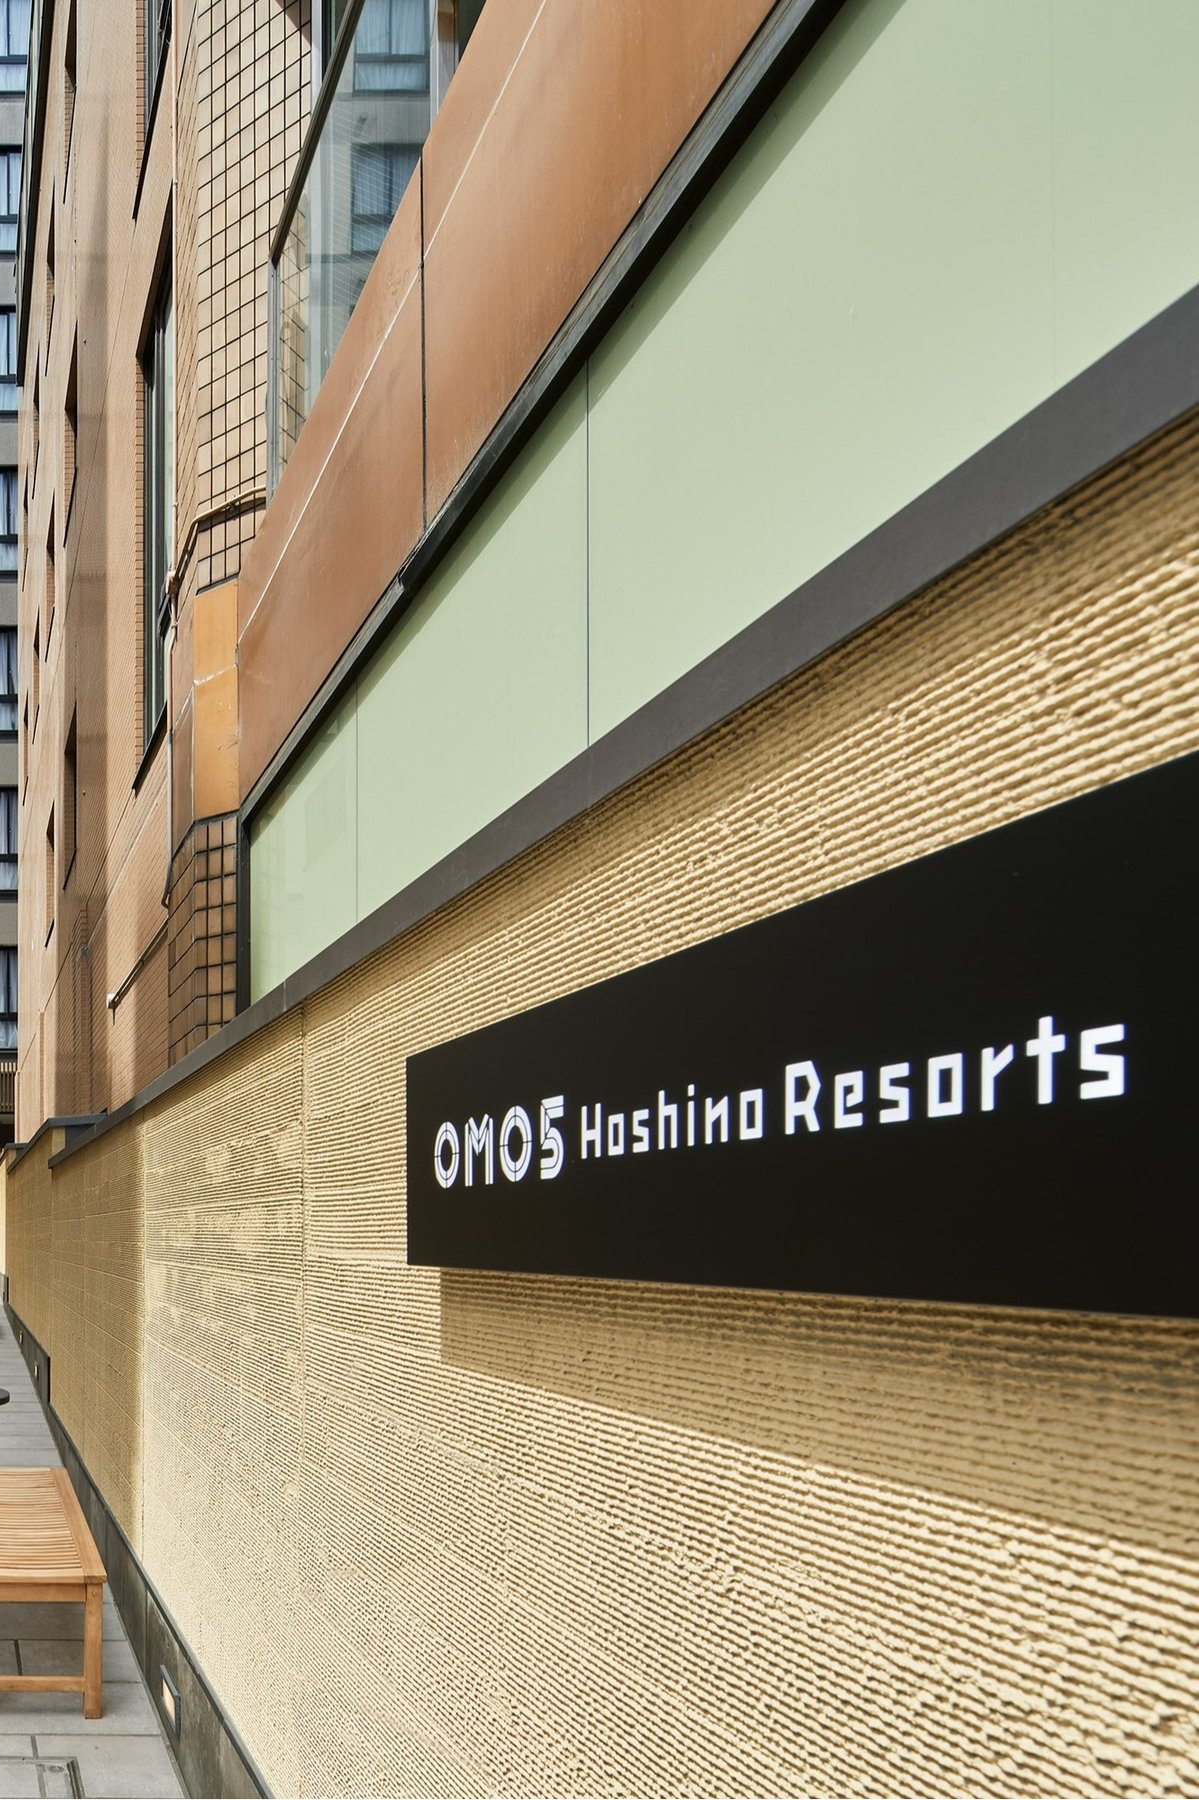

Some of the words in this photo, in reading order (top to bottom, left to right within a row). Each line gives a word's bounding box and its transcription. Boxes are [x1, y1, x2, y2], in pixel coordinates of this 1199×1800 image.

[433, 1094, 564, 1189] OMO5
[580, 1083, 763, 1160] Hoshino
[784, 1015, 1126, 1135] Resorts
